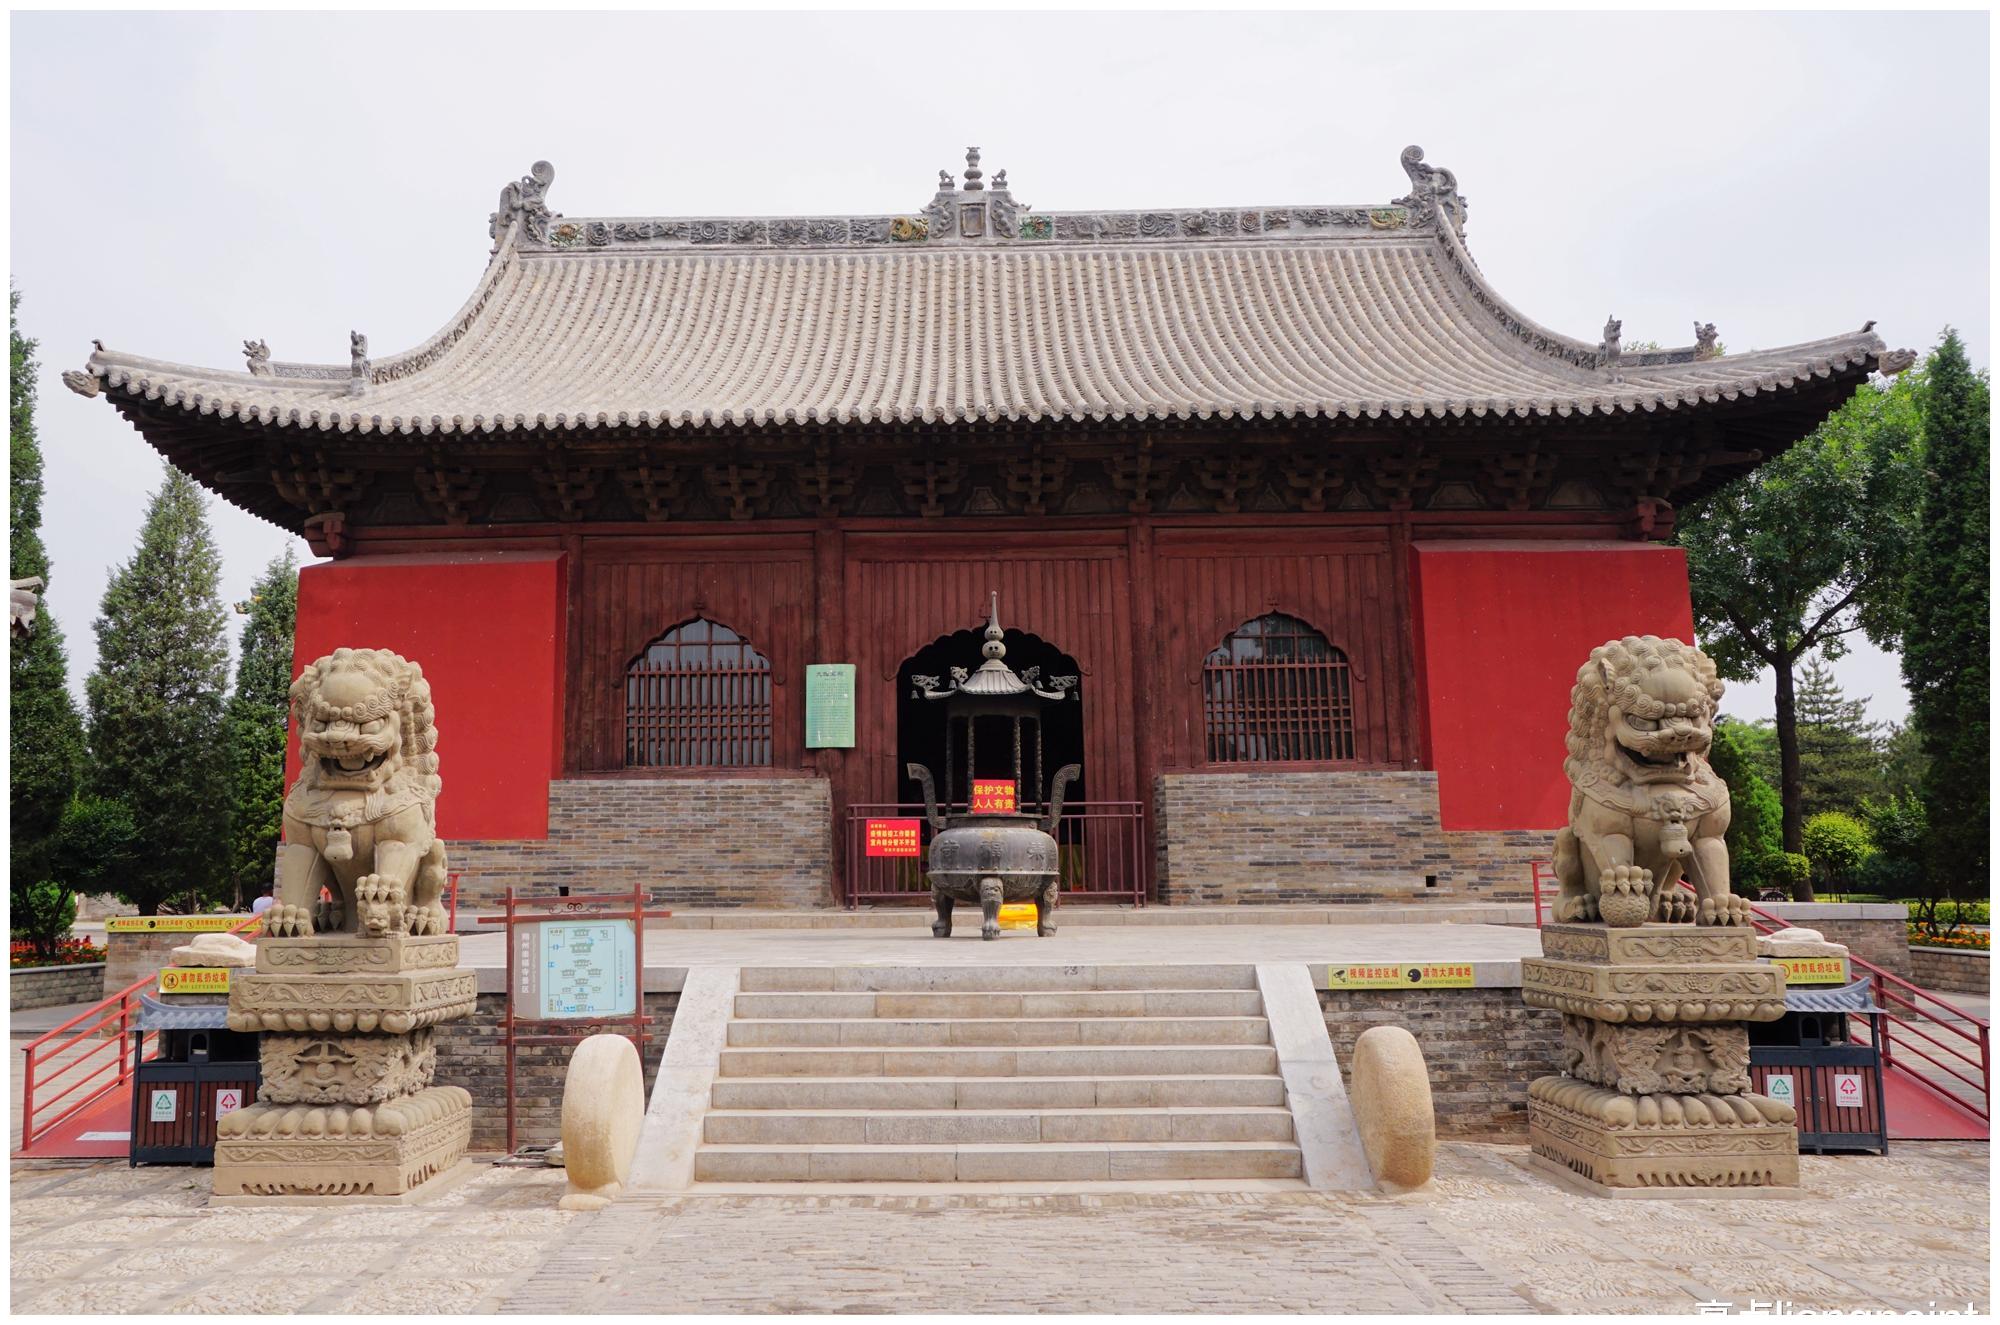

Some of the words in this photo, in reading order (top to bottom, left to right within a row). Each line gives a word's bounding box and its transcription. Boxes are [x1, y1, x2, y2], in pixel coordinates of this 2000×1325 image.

[974, 785, 1014, 796] 保护文物
[974, 799, 1014, 809] 人人有责
[1349, 967, 1399, 979] 视频监控区域
[1793, 962, 1841, 973] 请勿乱扔垃圾
[181, 972, 227, 983] 请勿乱扔垃圾
